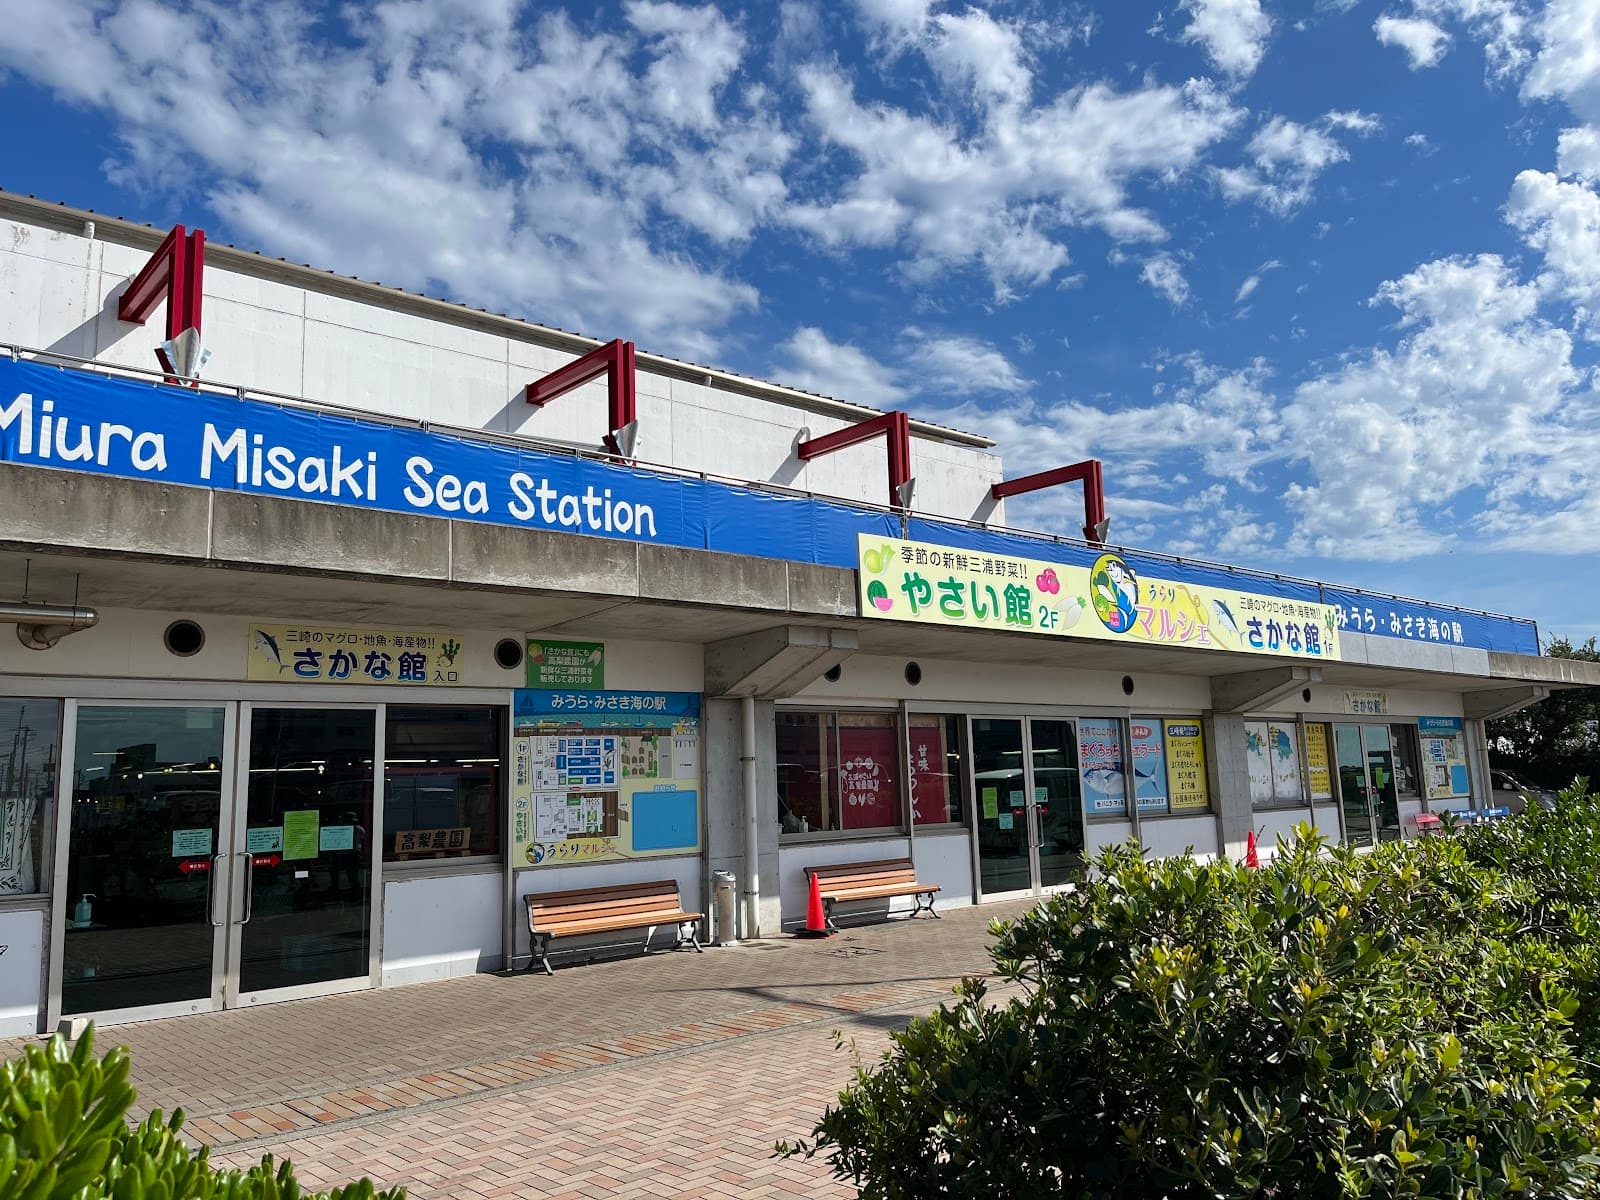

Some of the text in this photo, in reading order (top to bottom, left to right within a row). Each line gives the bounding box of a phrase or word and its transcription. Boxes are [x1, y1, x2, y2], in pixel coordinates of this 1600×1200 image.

[0, 393, 657, 537] Miura Misaki Sea Station
[900, 546, 1028, 580] 季節の新鮮三浦野菜!!
[901, 571, 1059, 629] やさい館 2F
[1149, 584, 1175, 603] うらり
[286, 629, 436, 649] 三崎のマグロ・地魚・海産物!!
[1135, 604, 1211, 645] マルシェ
[1246, 616, 1334, 655] さかな館 1F
[1335, 603, 1465, 644] みうら・みさき海の駅
[293, 646, 460, 684] さかな館 入口
[551, 694, 668, 712] みうら・みさき海の駅
[518, 743, 529, 755] 1F
